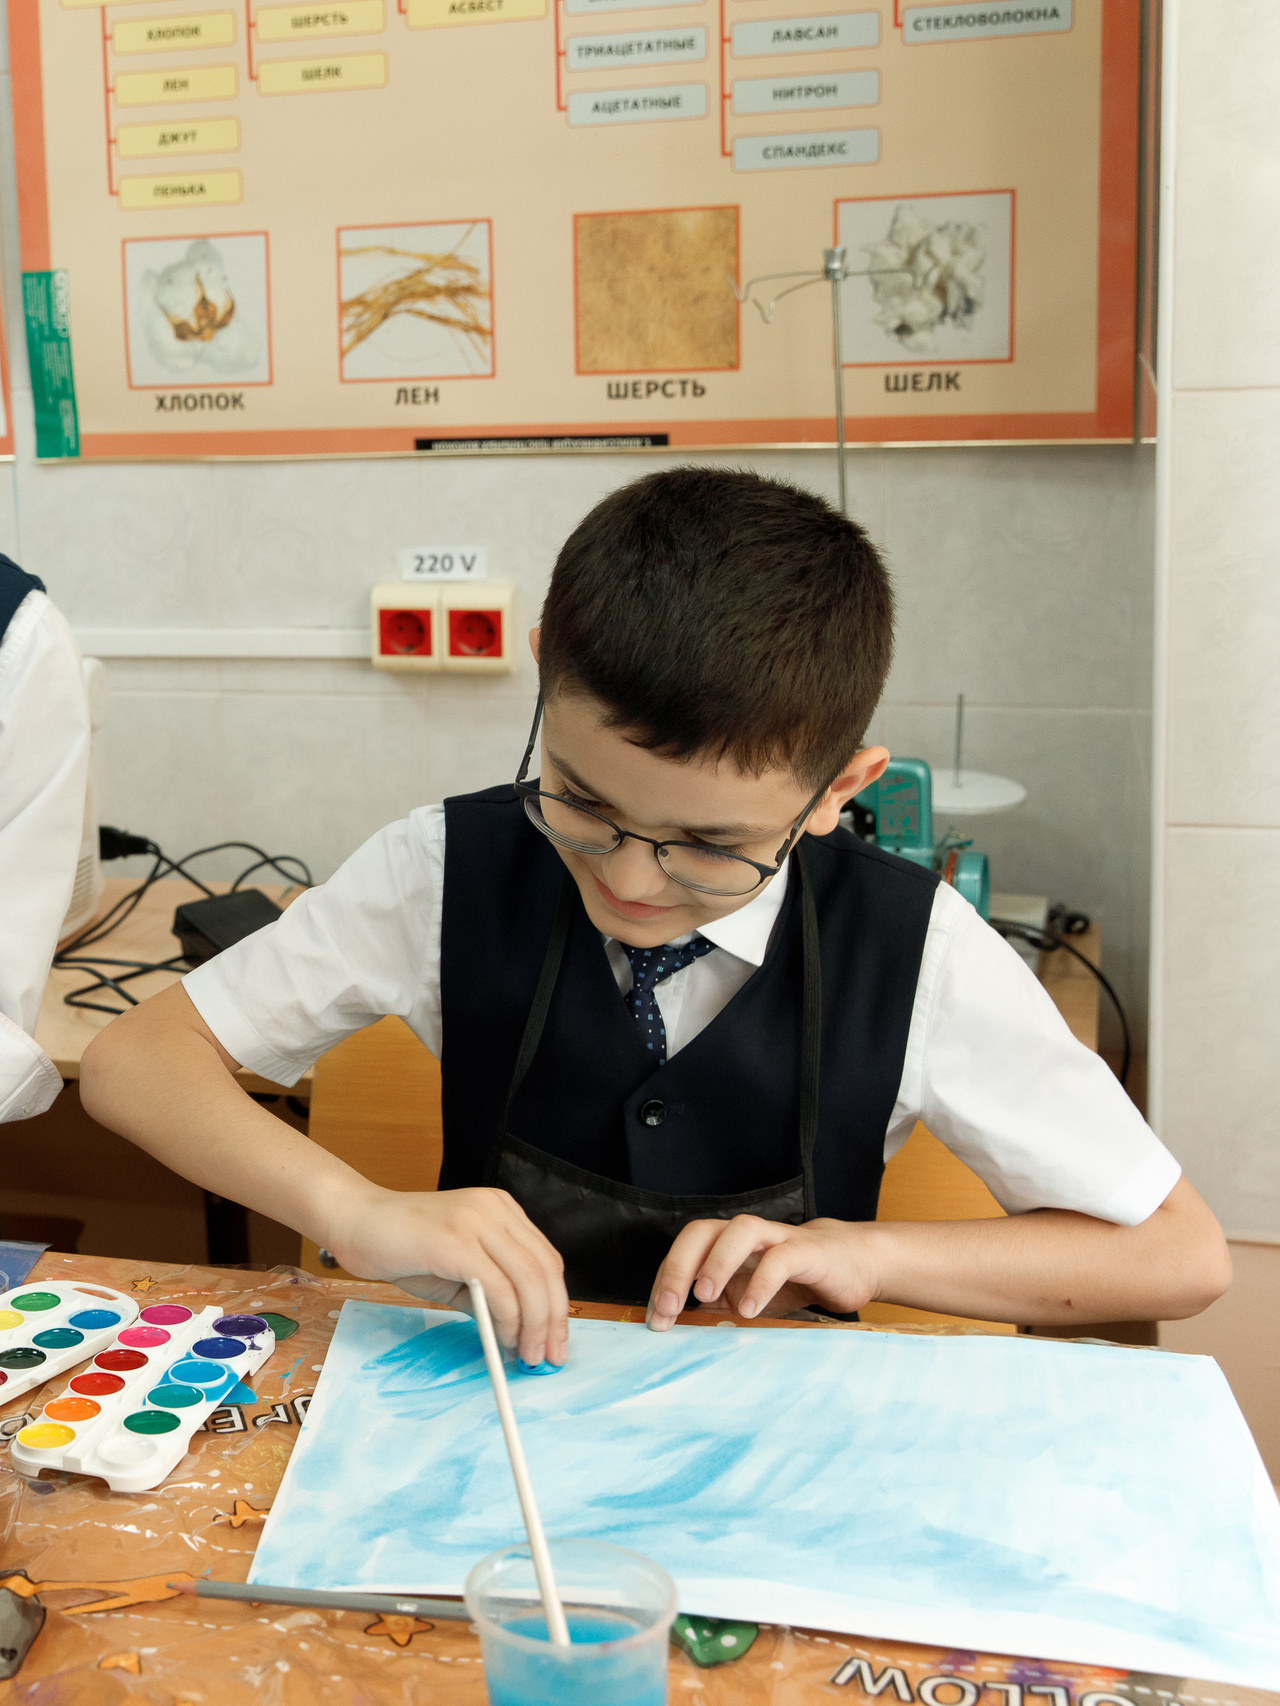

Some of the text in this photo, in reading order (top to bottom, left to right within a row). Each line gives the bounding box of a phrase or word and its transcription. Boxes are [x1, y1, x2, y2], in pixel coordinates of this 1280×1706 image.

[291, 11, 348, 29] ШЕРСТЬ
[911, 5, 1062, 33] СТЕКЛОВОЛОКНА
[146, 24, 201, 41] ХЛОПОК
[771, 23, 839, 43] ЛАВСАН
[576, 36, 697, 60] ТРИАЦЕТАТНЫЕ
[301, 65, 342, 81] ШЕЛК
[162, 77, 189, 92] ЛЕН
[772, 81, 838, 100] НИТРОН
[591, 93, 682, 117] АЦЕТАТНЫЕ
[158, 129, 197, 147] ДЖУТ
[762, 139, 849, 162] СПАНДЕКС
[153, 182, 207, 199] ПЕНЬКА
[607, 378, 707, 400] ШЕРСТЬ
[883, 371, 962, 394] ШЕЛК
[155, 393, 245, 412] ХЛОПОК
[394, 387, 440, 406] ЛЕН
[414, 553, 477, 574] 220 V
